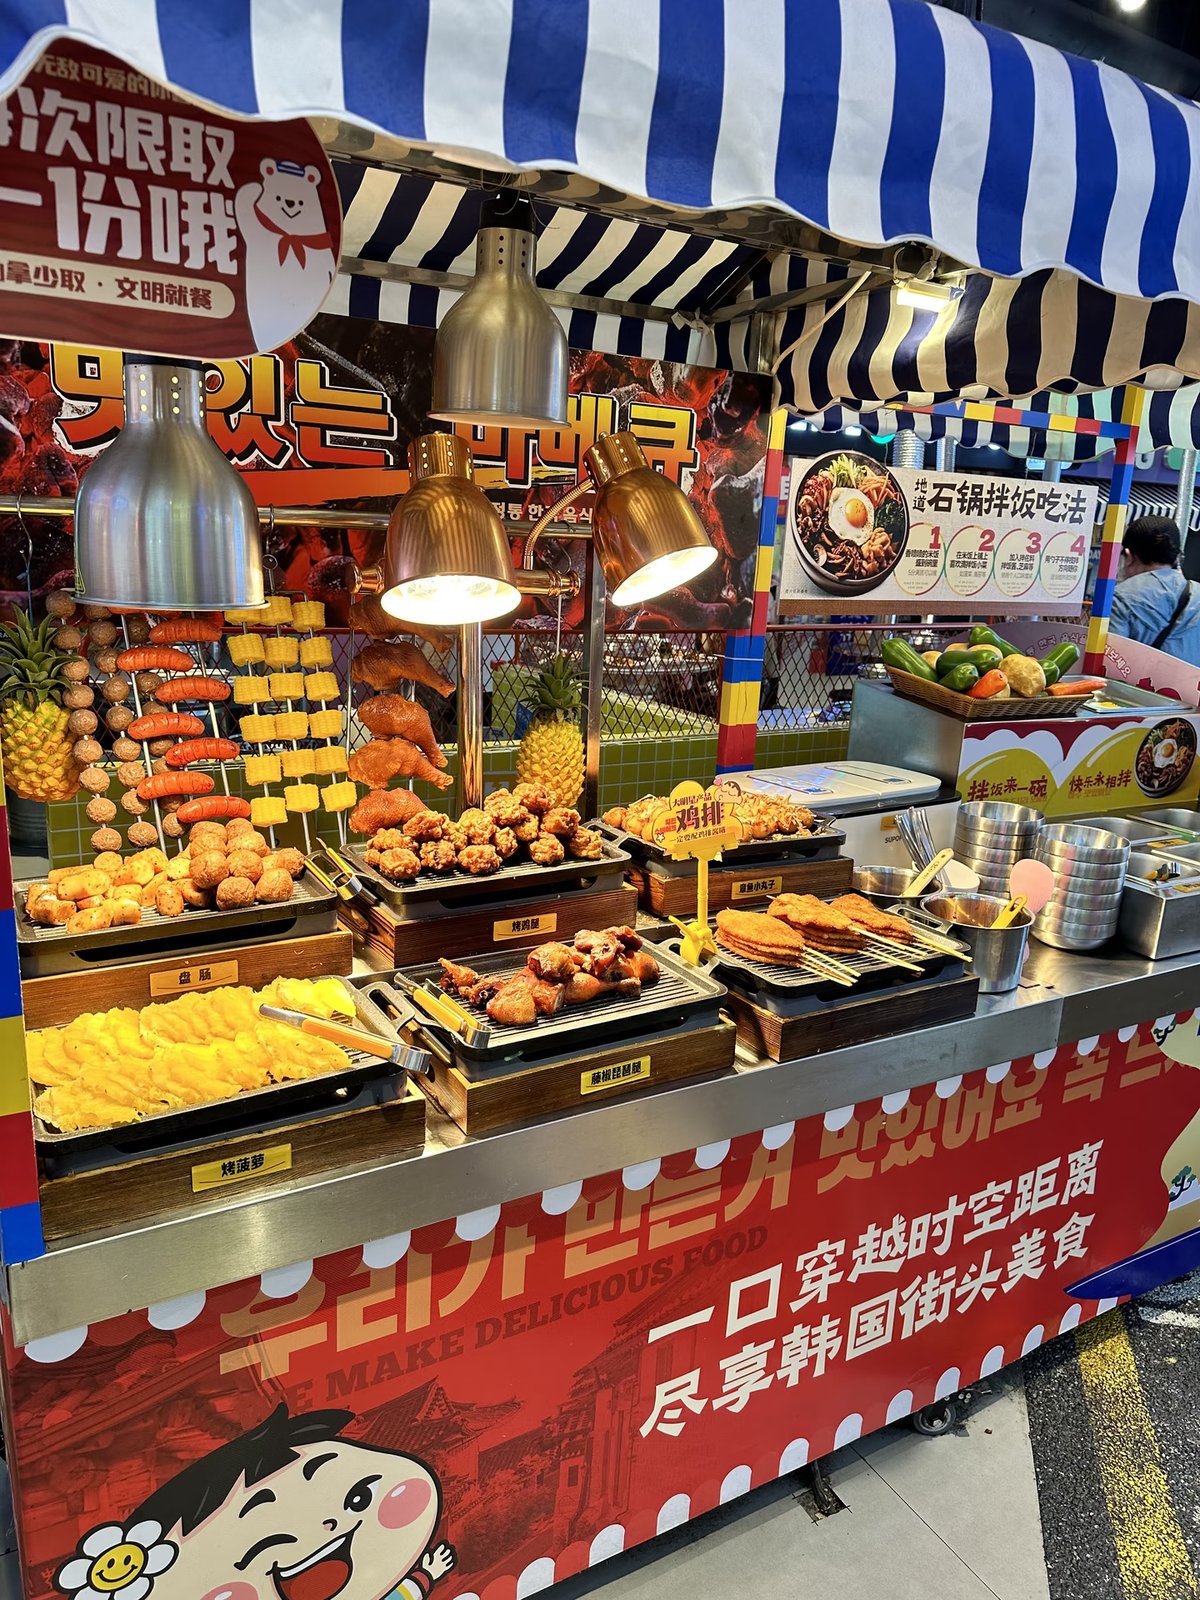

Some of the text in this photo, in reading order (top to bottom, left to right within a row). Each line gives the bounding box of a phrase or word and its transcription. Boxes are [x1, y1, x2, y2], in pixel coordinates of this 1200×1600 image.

[0, 86, 236, 190] 次限取
[0, 166, 238, 275] 一份哦
[0, 260, 212, 310] 拿少取 文明就餐
[912, 477, 929, 513] 地道
[927, 479, 1088, 526] 石锅拌饭吃法
[527, 503, 559, 523] 한
[929, 526, 941, 549] 1
[978, 529, 996, 551] 2
[1025, 532, 1042, 554] 3
[1070, 535, 1086, 556] 4
[1104, 644, 1132, 679] 보세요
[967, 775, 1049, 802] 拌饭来一碗
[1069, 769, 1132, 794] 快乐永相拌
[676, 800, 724, 834] 鸡排
[739, 879, 776, 894] 章鱼小丸子
[511, 917, 540, 933] 烤鸡腿
[591, 1060, 642, 1086] 藤椒琵琶腿
[220, 1152, 265, 1177] 烤菠萝
[648, 1138, 1104, 1345] 一口穿越时空距离
[326, 1327, 464, 1402] MAKE
[474, 1255, 674, 1351] DELICIOUS
[682, 1224, 769, 1274] FOOD
[639, 1212, 1096, 1439] 尽享韩国街头美食
